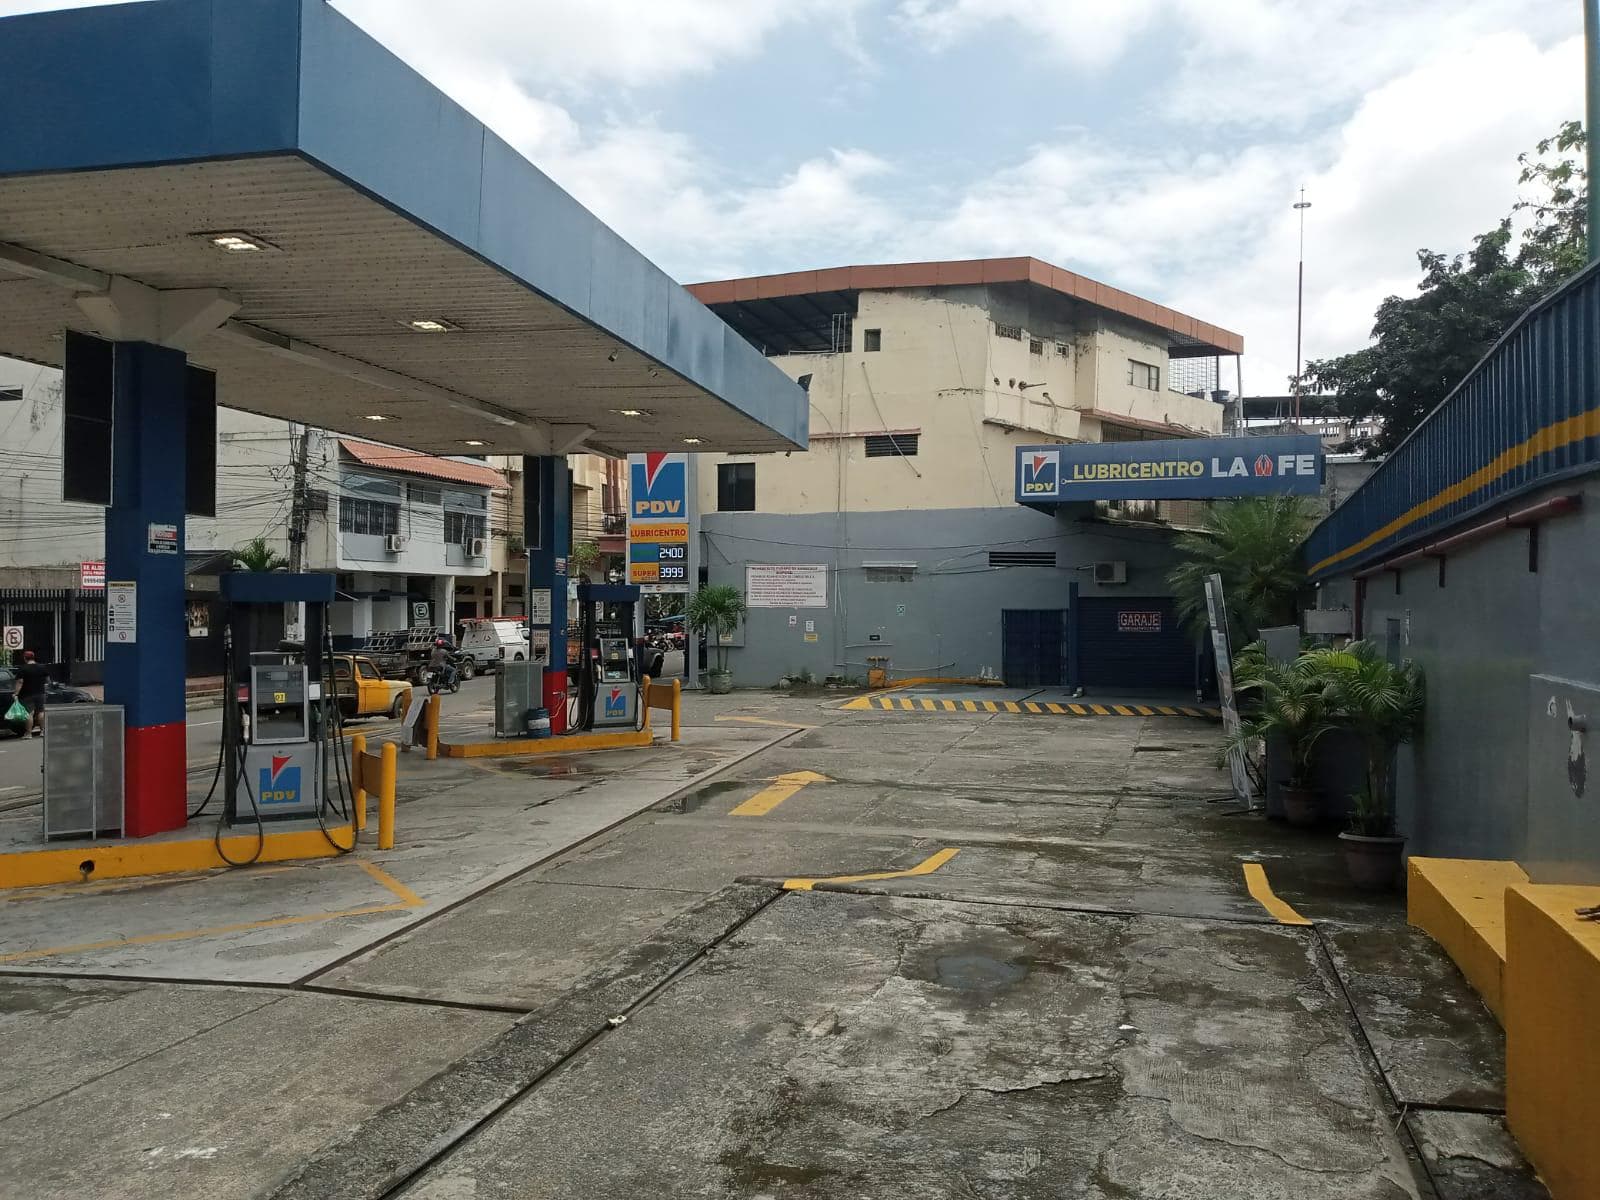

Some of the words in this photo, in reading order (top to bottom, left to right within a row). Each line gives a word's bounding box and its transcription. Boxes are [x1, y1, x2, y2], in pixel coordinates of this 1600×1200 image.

[1073, 460, 1204, 480] LUBRICENTRO
[1211, 456, 1249, 478] LA
[1278, 454, 1315, 476] FE
[1025, 482, 1054, 492] PDV
[636, 500, 681, 514] PDV
[630, 528, 686, 538] LUBRICENTRO
[659, 548, 684, 558] 2400
[660, 567, 684, 578] 3999
[1120, 613, 1159, 626] GARAJE
[261, 790, 296, 801] PDV
